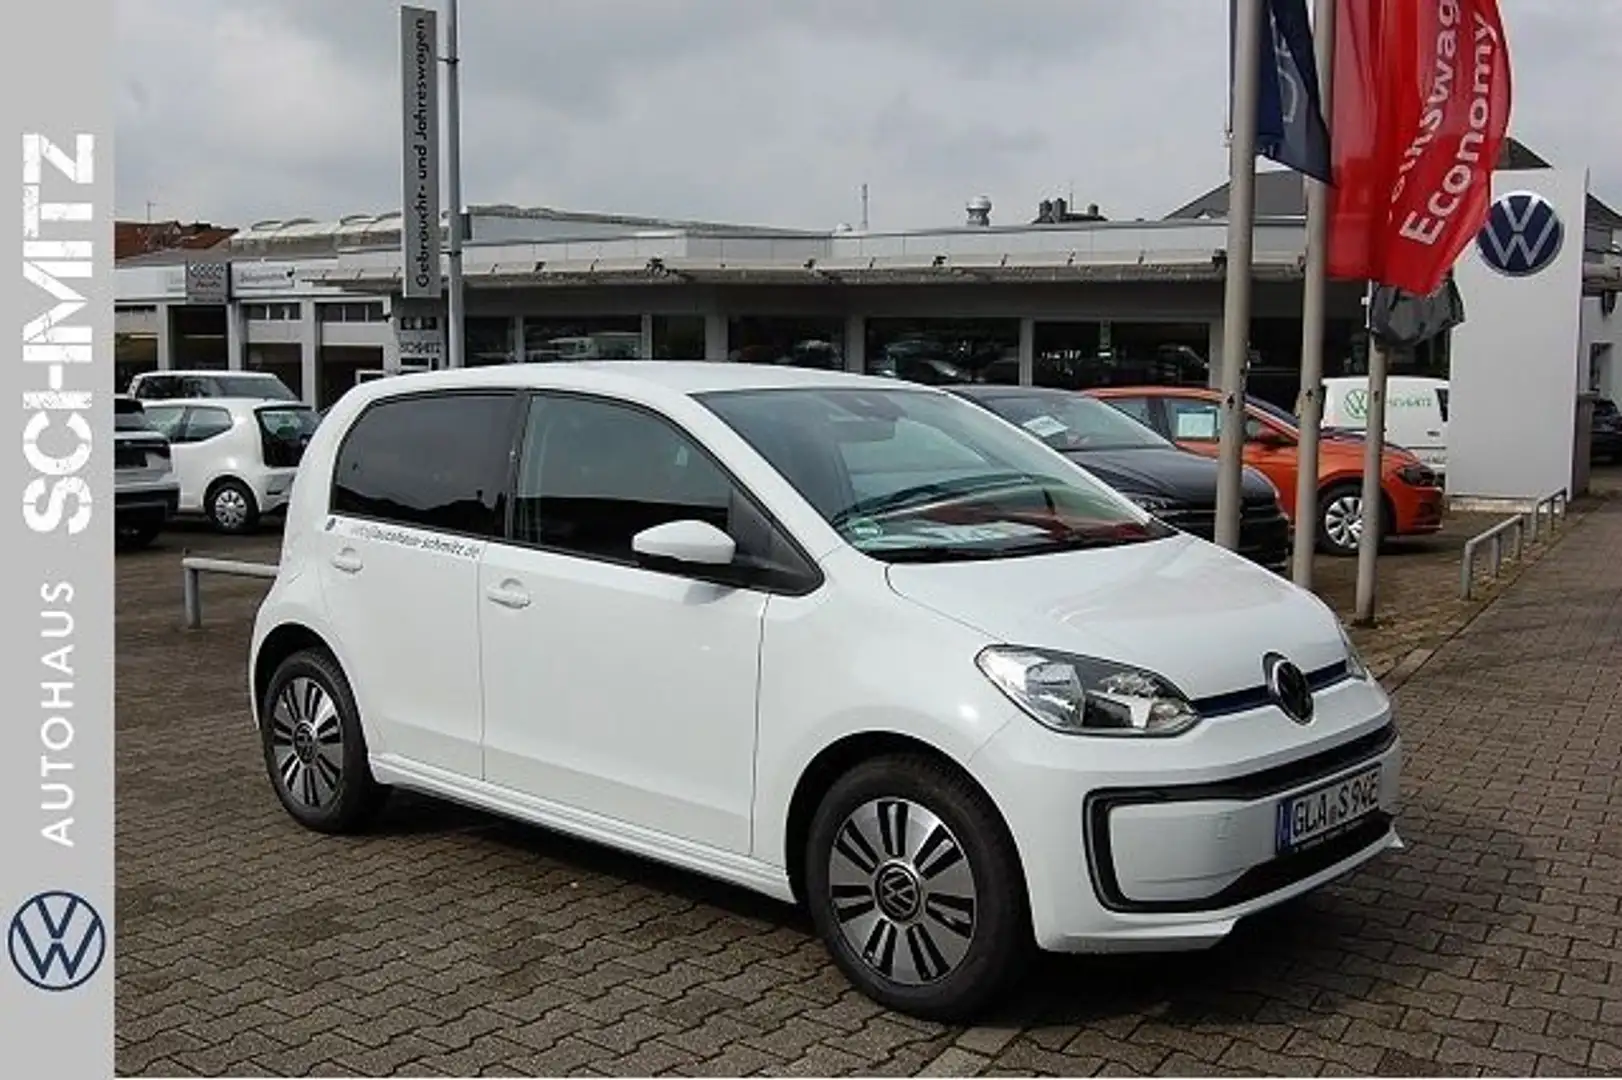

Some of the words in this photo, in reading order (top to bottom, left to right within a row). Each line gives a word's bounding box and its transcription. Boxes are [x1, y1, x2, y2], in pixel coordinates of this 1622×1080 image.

[413, 18, 431, 140] Jahreswagen
[1400, 12, 1497, 245] Economy
[413, 144, 428, 180] und
[413, 184, 430, 289] Gebraucht-
[1478, 190, 1565, 278] VW
